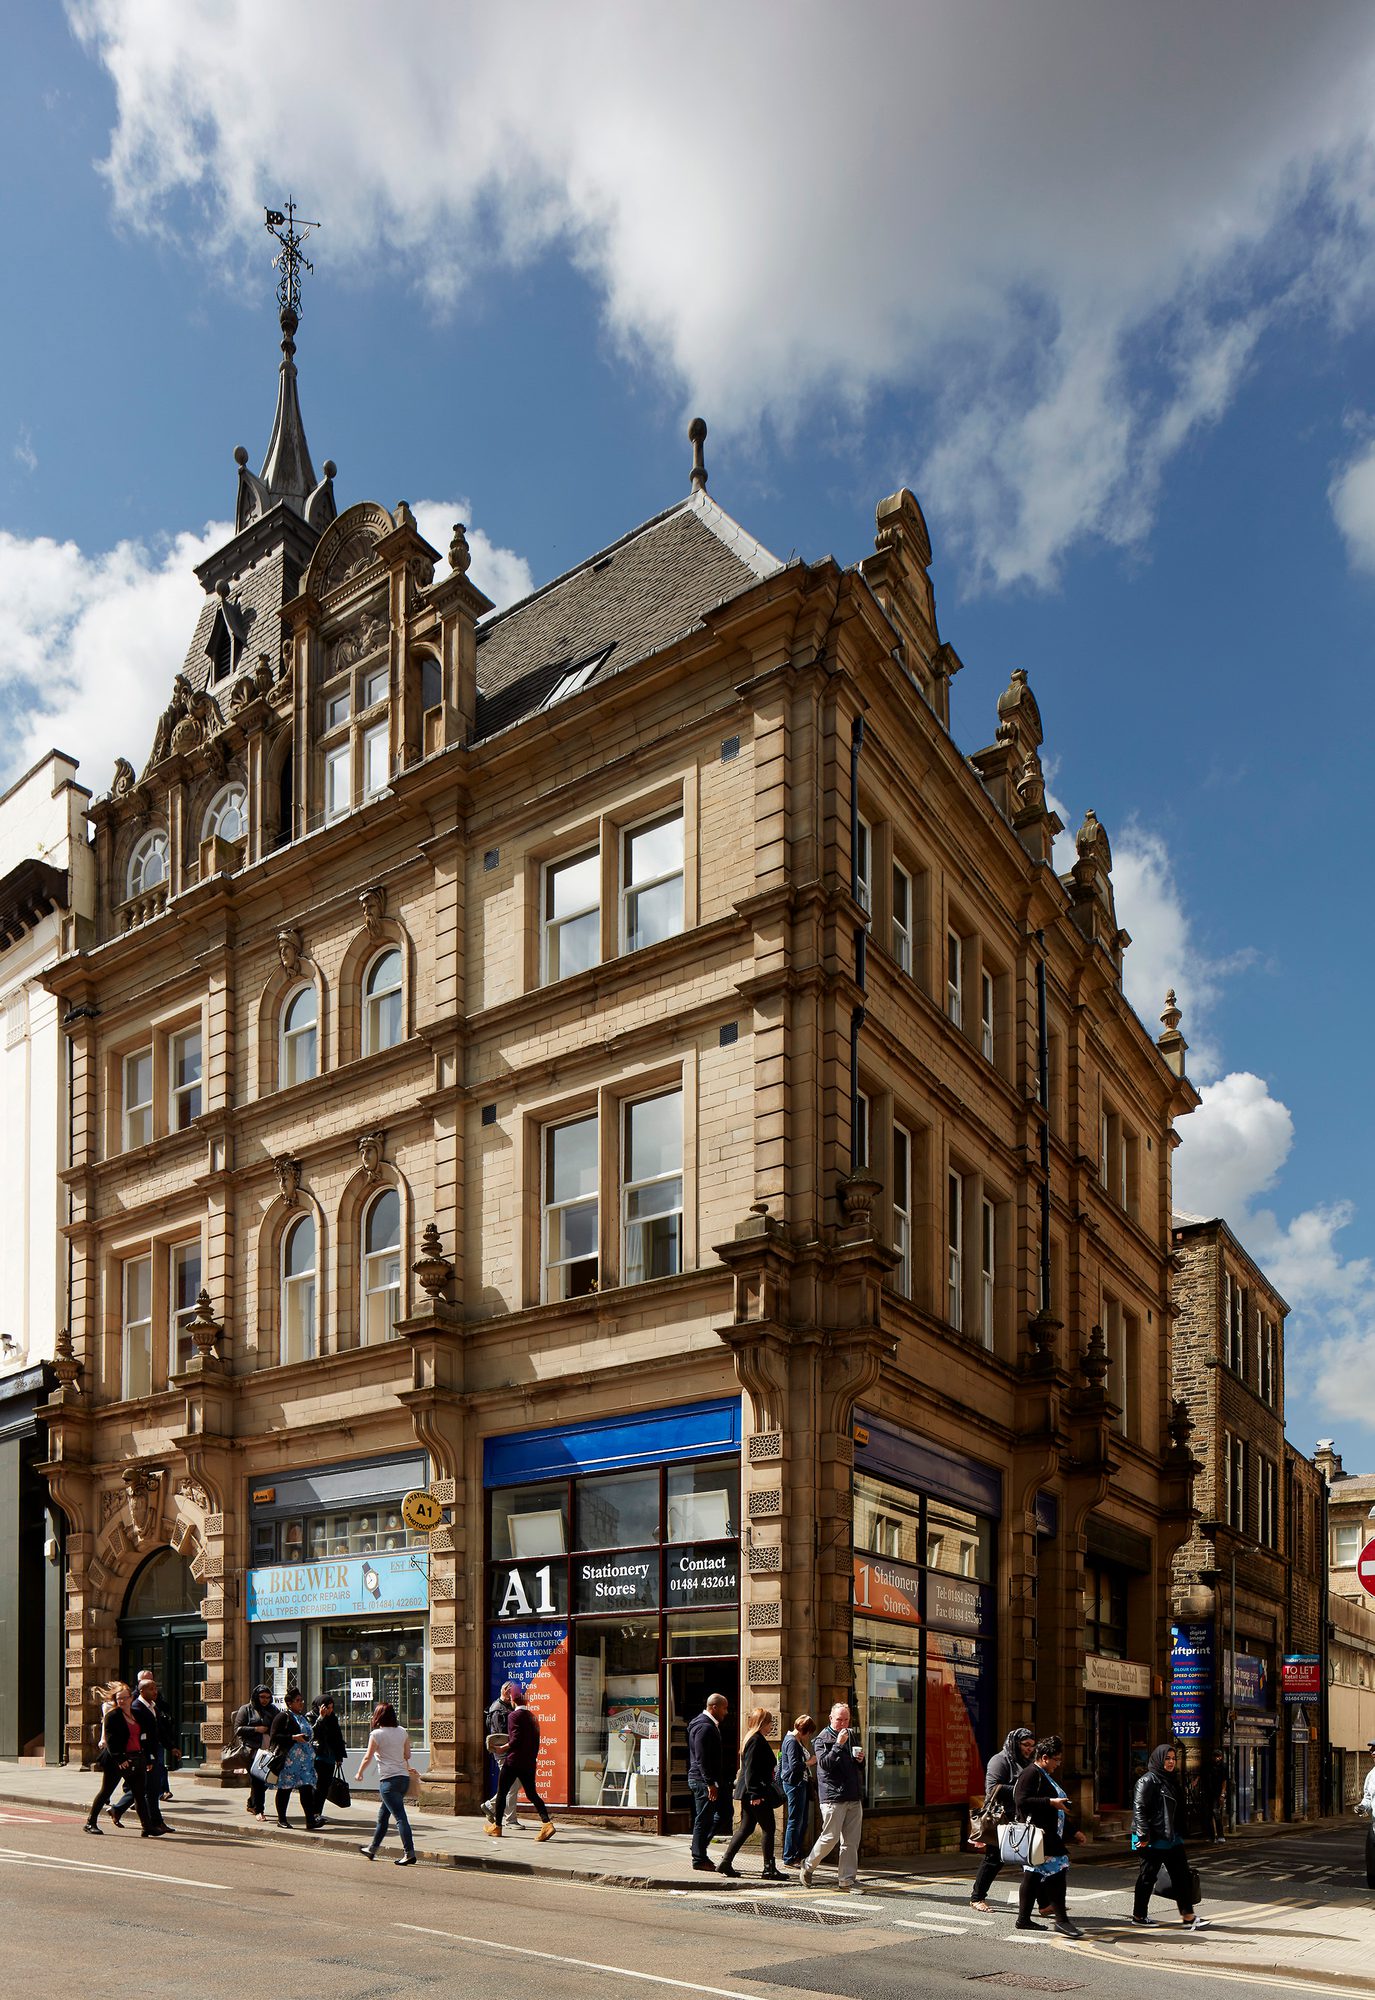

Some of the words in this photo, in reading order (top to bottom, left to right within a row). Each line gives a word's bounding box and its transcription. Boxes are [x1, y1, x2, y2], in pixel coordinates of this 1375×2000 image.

[406, 1492, 440, 1506] STATIONERY
[416, 1504, 432, 1518] A1
[680, 1556, 726, 1572] Contact
[582, 1563, 650, 1580] Stationery
[269, 1566, 349, 1596] BREWER
[670, 1578, 698, 1592] 01484
[700, 1574, 736, 1590] 432614
[854, 1564, 872, 1608] 1
[874, 1566, 920, 1598] Stationery
[498, 1565, 556, 1616] A1
[595, 1582, 636, 1598] Stores
[936, 1586, 947, 1600] Tel:
[250, 1596, 274, 1608] WATCH
[275, 1595, 290, 1606] AND
[292, 1593, 317, 1604] CLOCK
[320, 1590, 350, 1602] REPAIRS
[352, 1601, 366, 1612] TEL
[368, 1598, 394, 1610] (01484)
[396, 1596, 423, 1608] 422602
[883, 1594, 910, 1616] Stores
[261, 1607, 274, 1617] ALL
[276, 1605, 299, 1616] TYPES
[300, 1603, 337, 1614] REPAIRED
[936, 1604, 948, 1618] Fax:
[502, 1632, 518, 1640] WIDE
[519, 1631, 552, 1639] SELECTION
[492, 1640, 529, 1649] STATIONERY
[1171, 1646, 1210, 1657] iftprint
[494, 1650, 526, 1658] ACADEMIC
[533, 1648, 552, 1656] HOME
[503, 1660, 522, 1669] Lever
[522, 1660, 539, 1668] Arch
[540, 1659, 556, 1667] Files
[1284, 1666, 1298, 1675] TO
[1300, 1666, 1315, 1675] LET
[508, 1671, 524, 1681] Ring
[525, 1670, 551, 1679] Binders
[521, 1682, 537, 1690] Pens
[520, 1692, 550, 1702] hlighters
[538, 1714, 556, 1722] Fluid
[1171, 1726, 1201, 1734] 13737
[539, 1736, 557, 1746] idges
[536, 1769, 552, 1777] Card
[536, 1780, 551, 1788] oard
